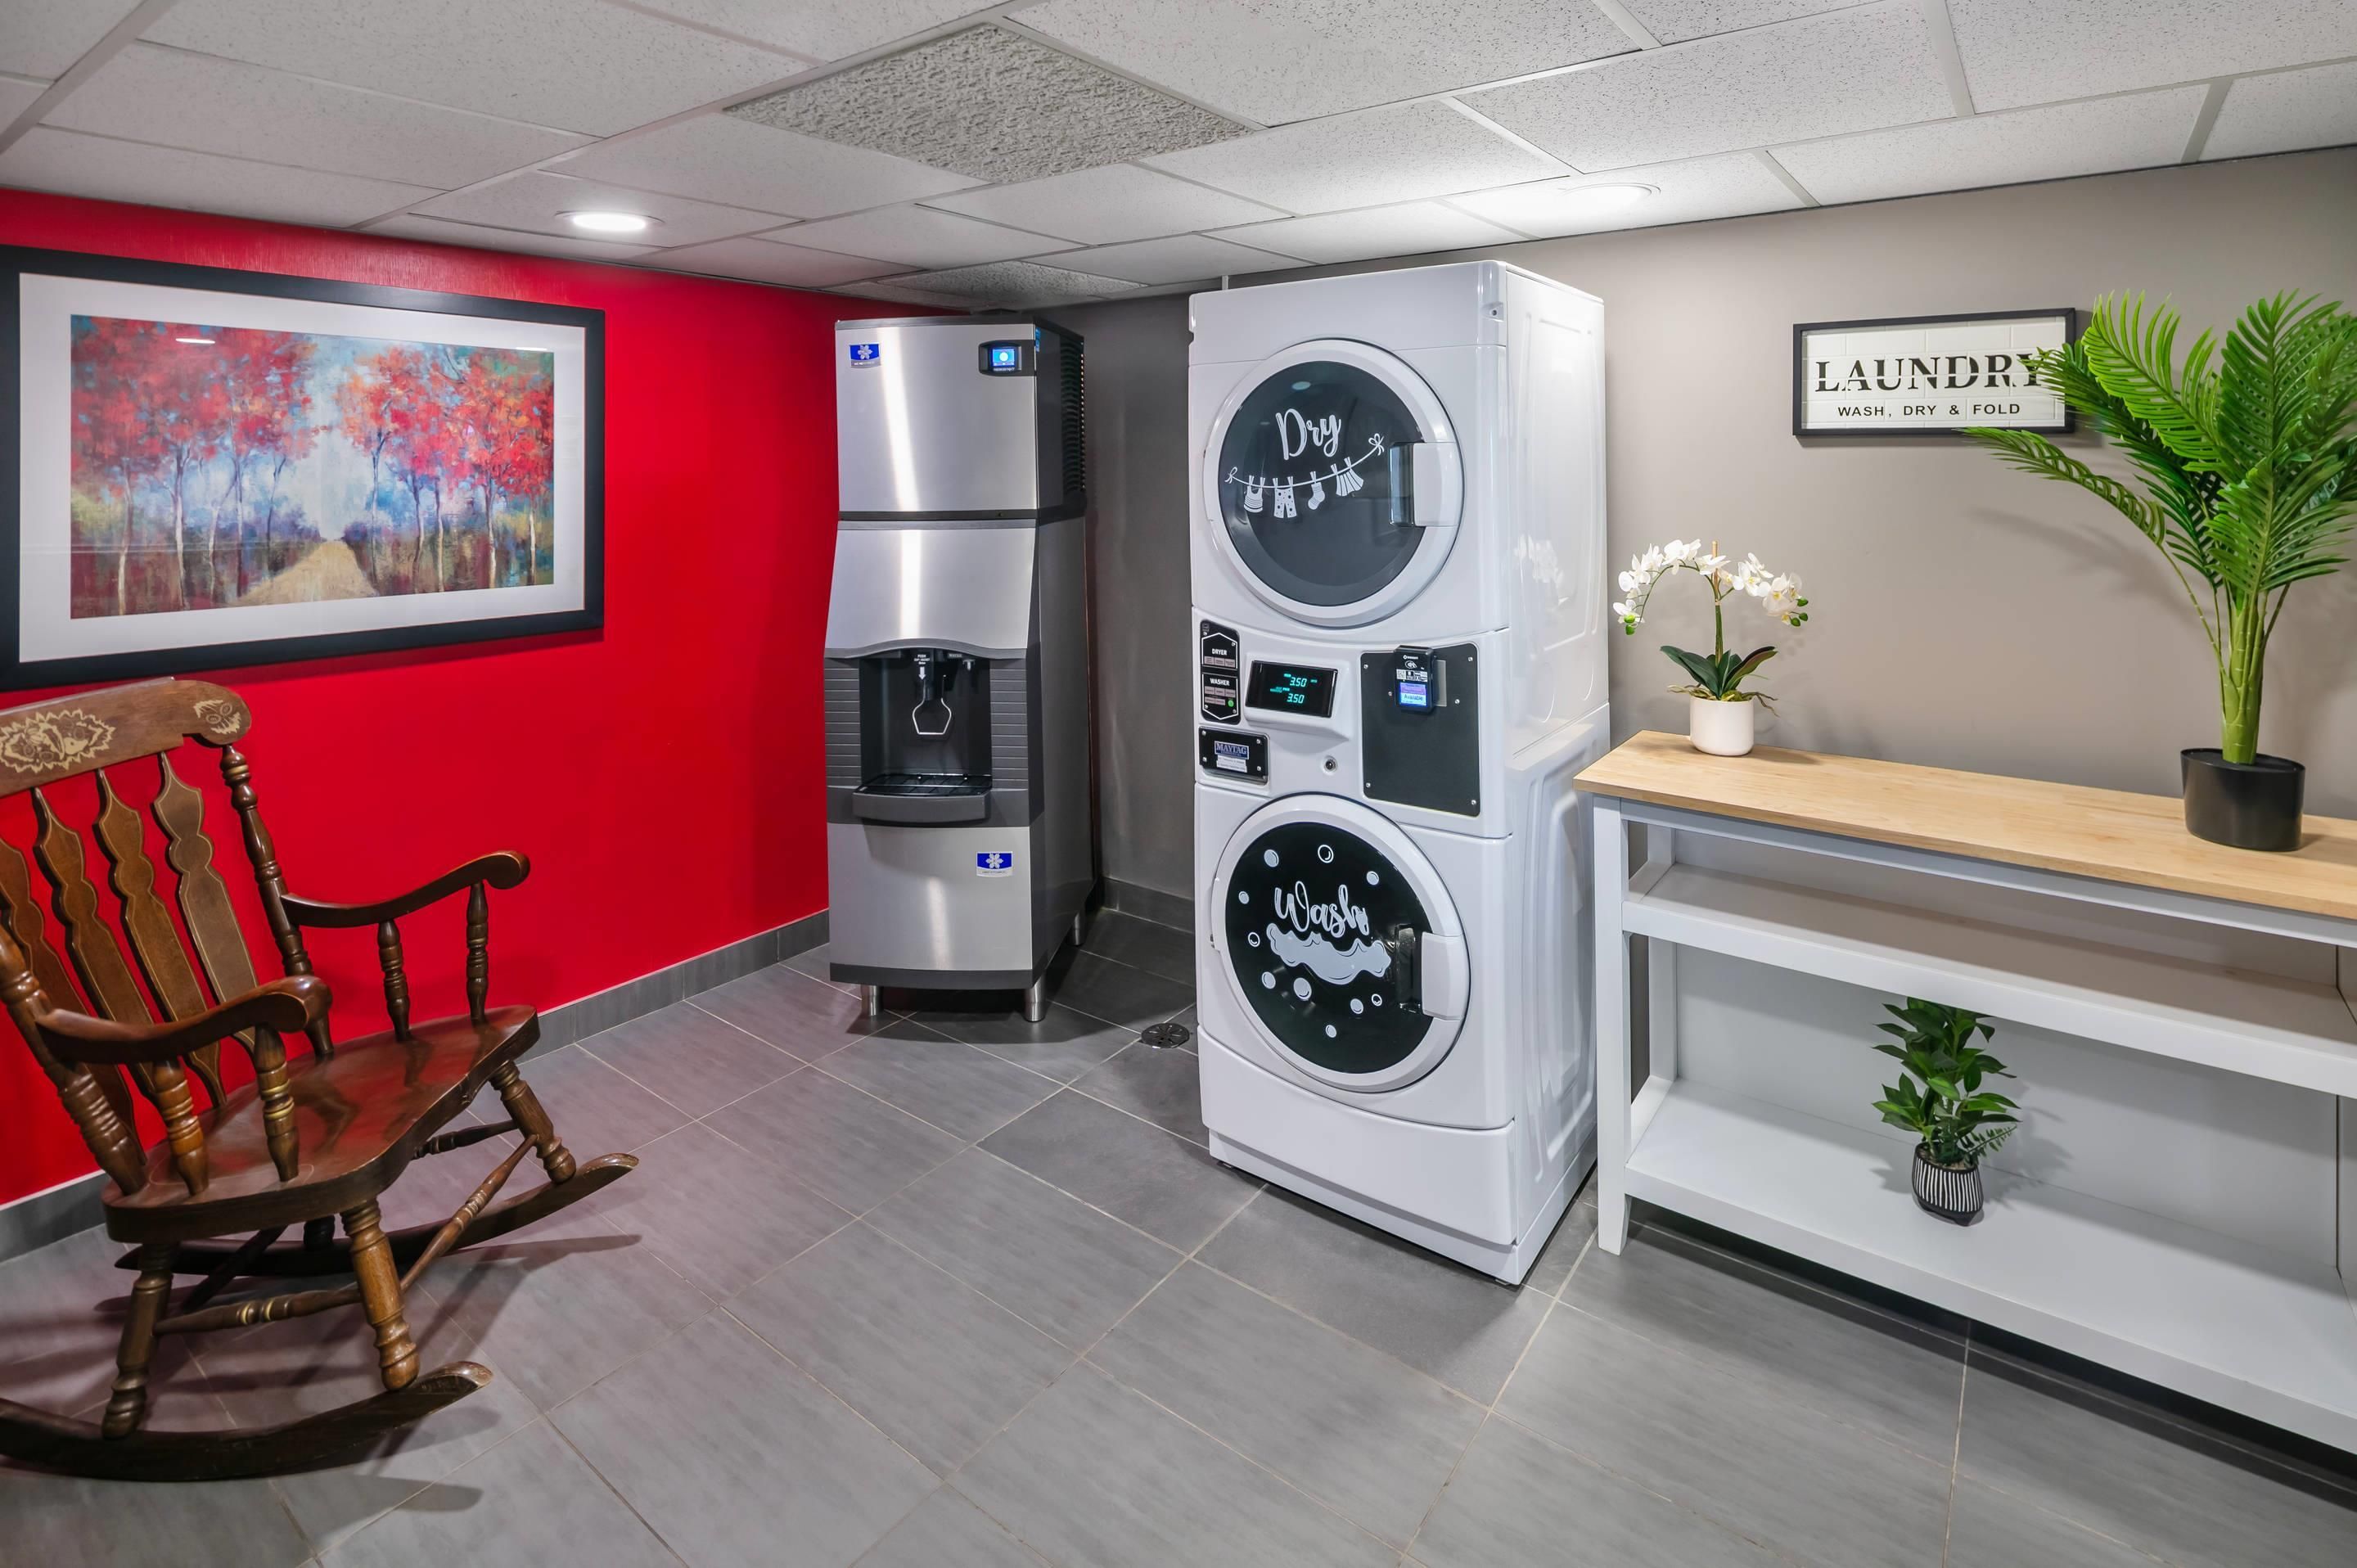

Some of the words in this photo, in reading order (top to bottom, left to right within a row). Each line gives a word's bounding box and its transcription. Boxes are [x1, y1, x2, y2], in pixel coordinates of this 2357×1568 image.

[1815, 353, 2043, 392] LAUNDRY
[1837, 406, 1892, 417] WASH,
[1903, 405, 1937, 416] DRY
[1949, 404, 1960, 416] &
[1972, 403, 2021, 415] FOLD
[1274, 408, 1342, 461] Dry
[1210, 678, 1230, 686] WASHER
[1216, 742, 1246, 755] MAYTAG
[1274, 881, 1370, 939] Wash
